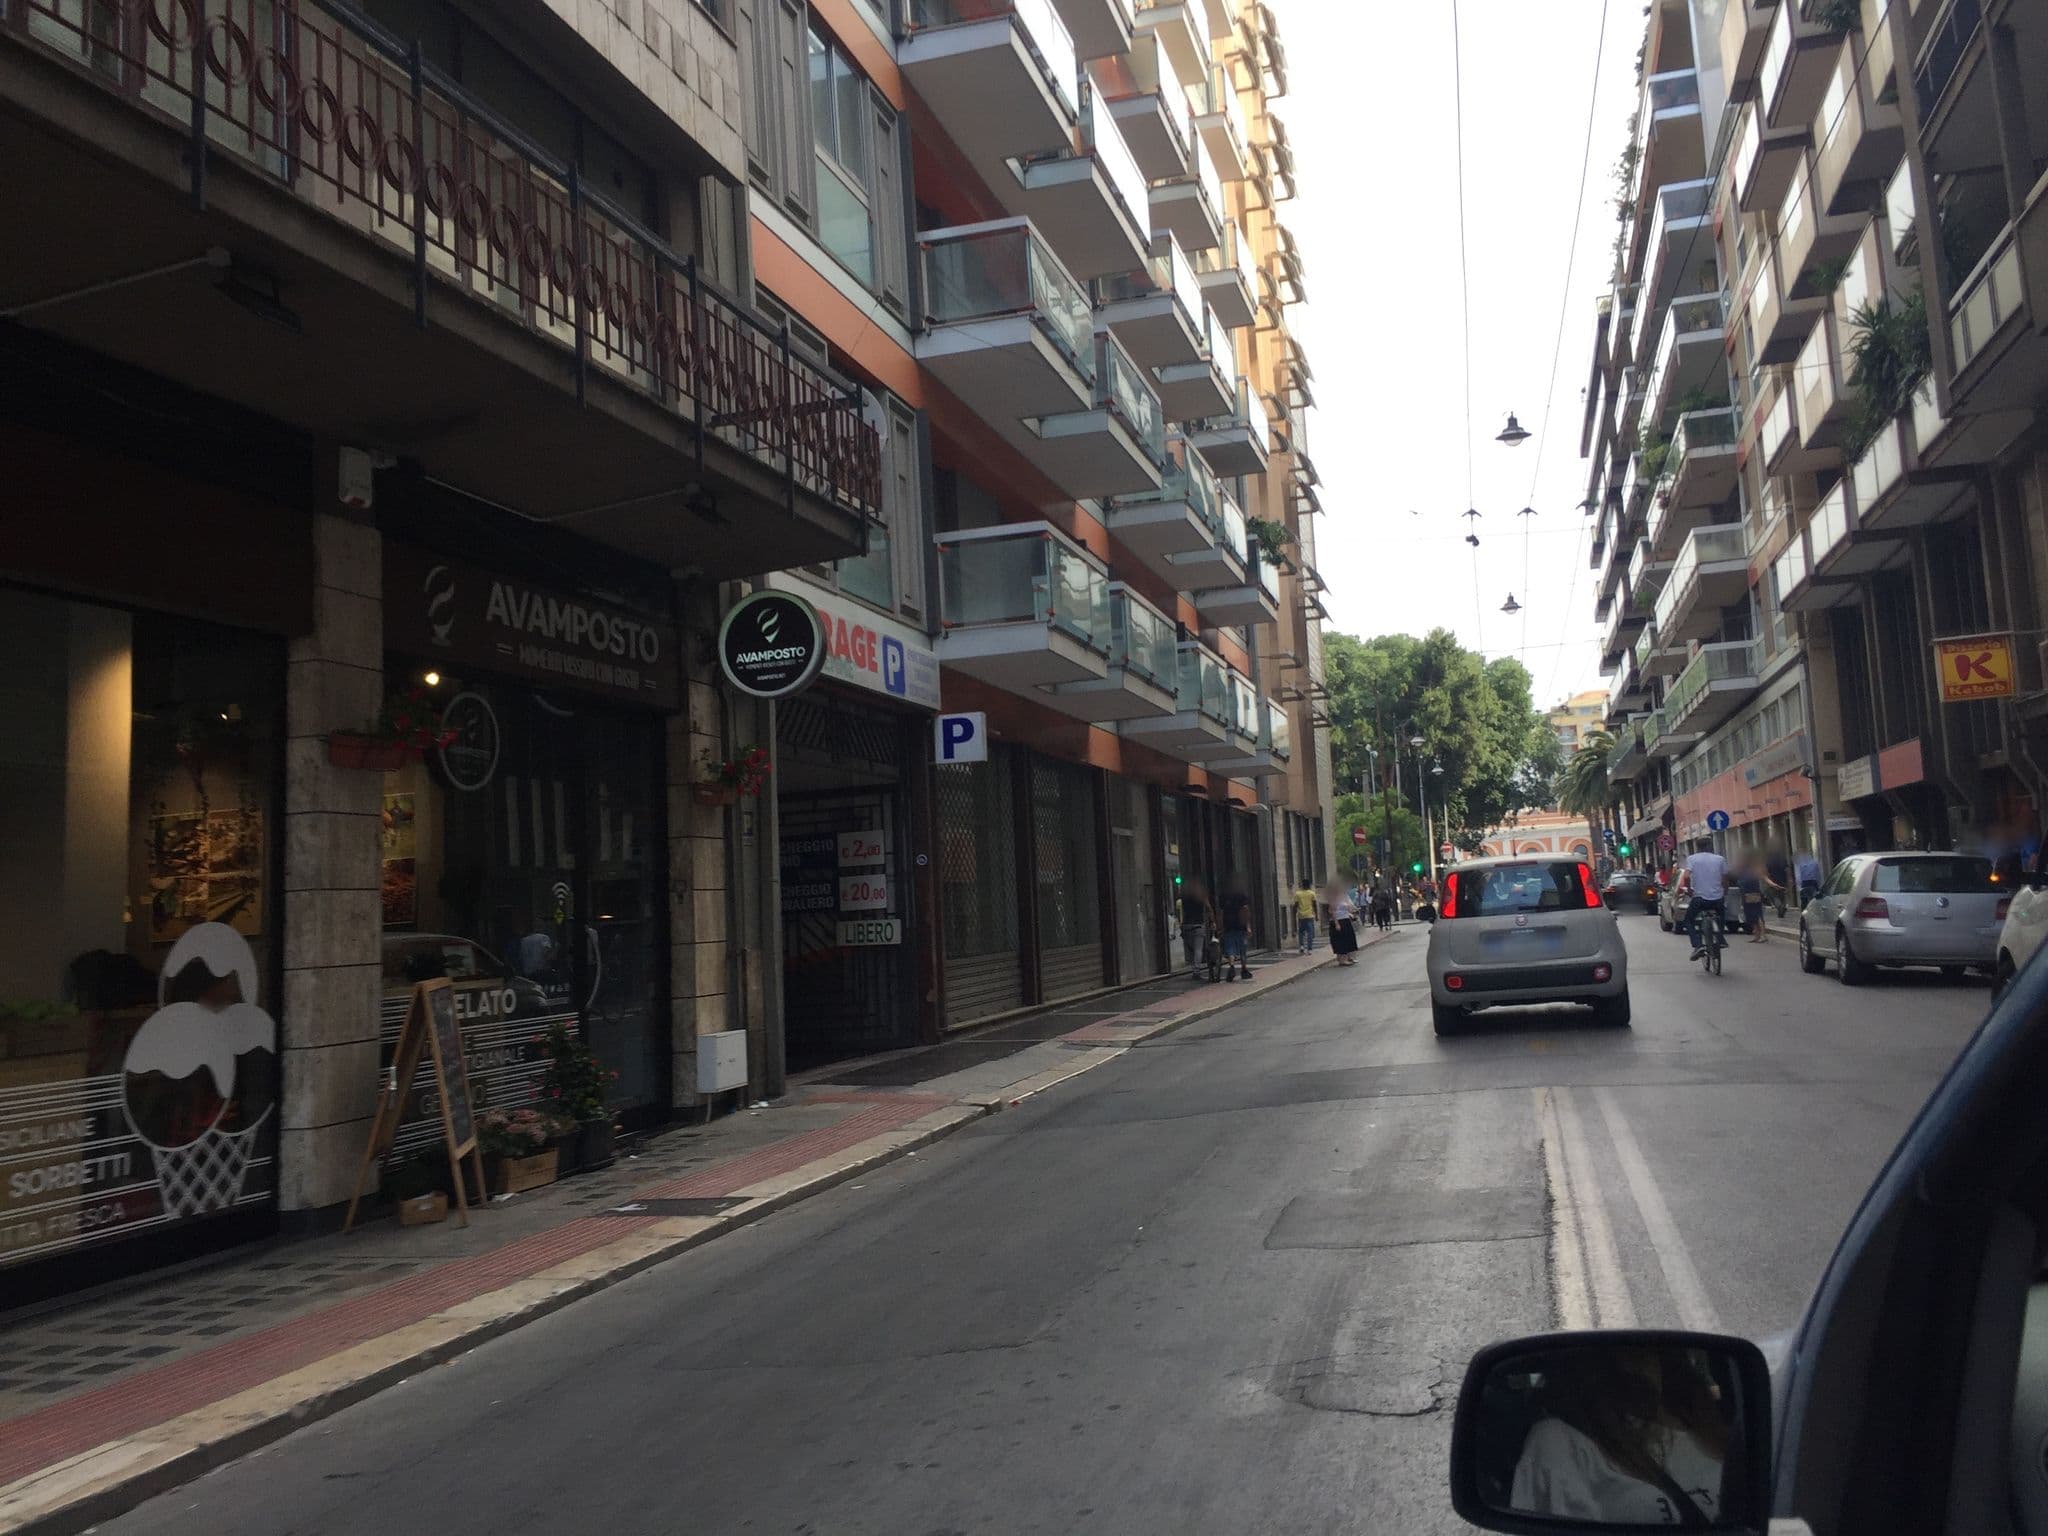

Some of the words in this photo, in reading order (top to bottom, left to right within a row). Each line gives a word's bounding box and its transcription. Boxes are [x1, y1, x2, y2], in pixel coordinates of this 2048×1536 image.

[486, 582, 659, 664] AVAMPOSTO
[736, 646, 806, 664] AVAMPOSTO
[817, 608, 878, 673] RAGE
[1955, 652, 1996, 681] K
[942, 717, 975, 760] P
[783, 896, 835, 912] NALIERO
[851, 882, 886, 902] 20,00
[845, 922, 895, 944] LIBERO
[454, 988, 517, 1018] ELATO
[464, 1045, 526, 1071] TIGIANALE
[9, 1152, 131, 1198] SORBETTI
[46, 1202, 127, 1237] FRESCA
